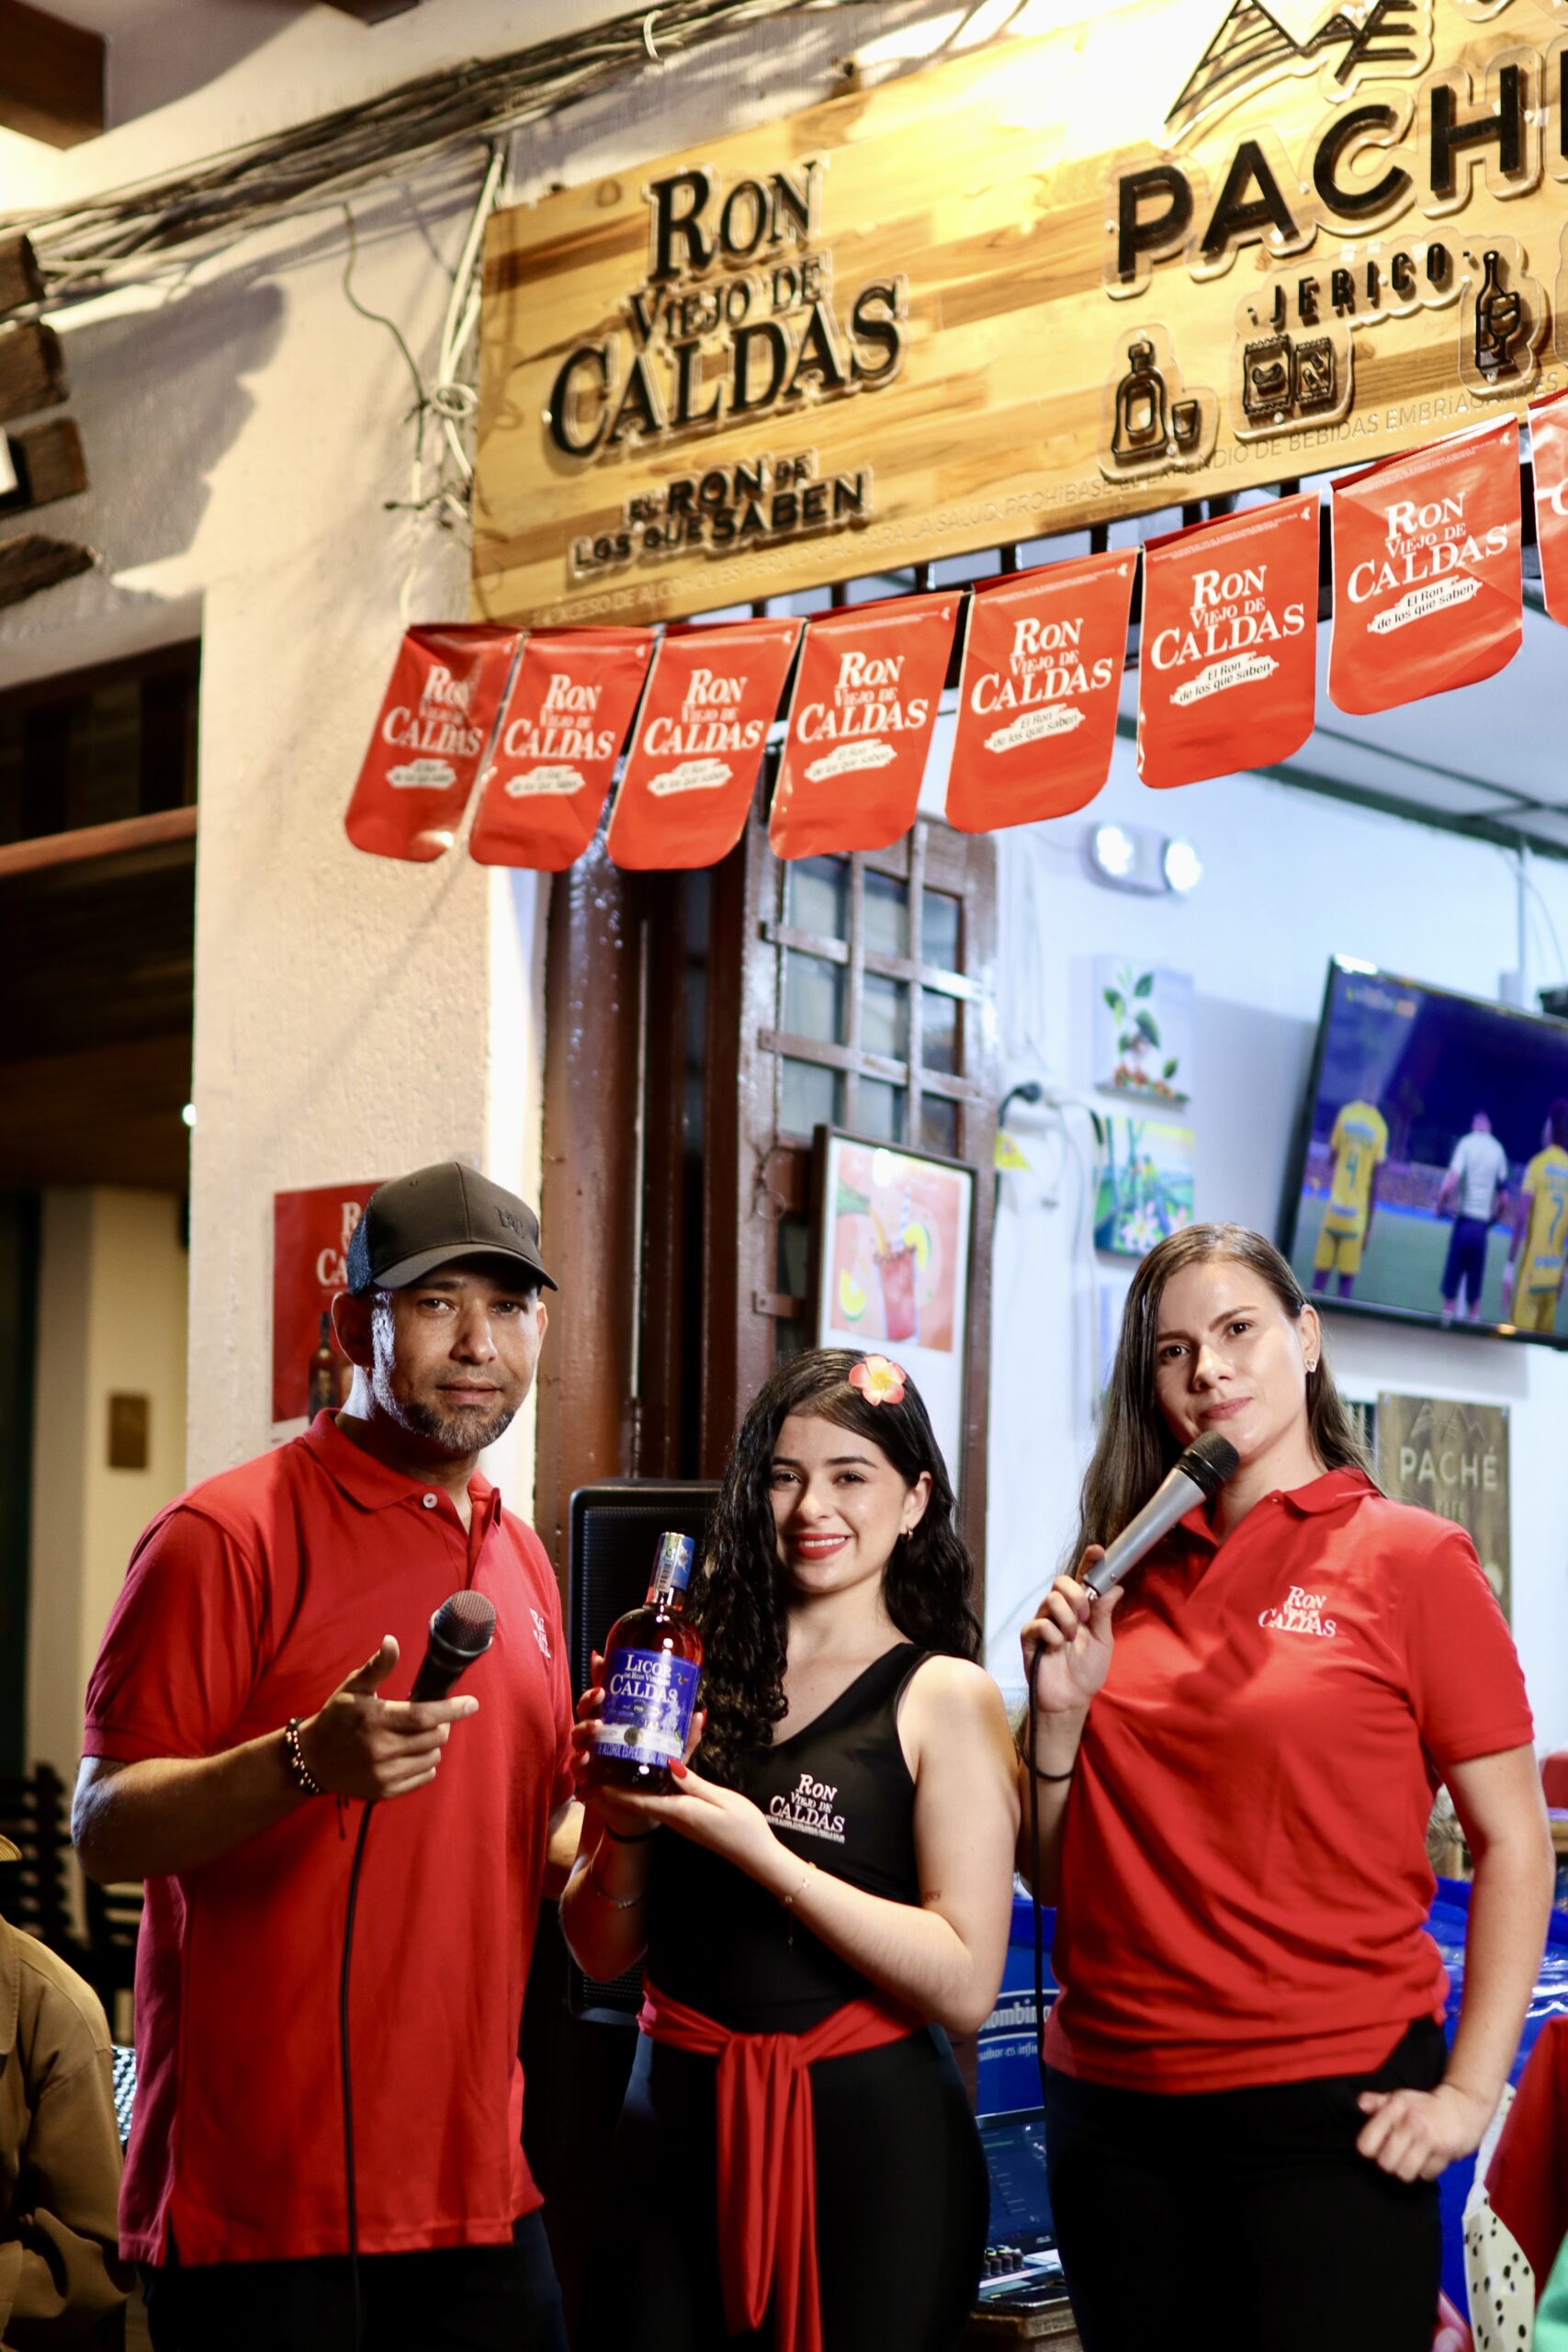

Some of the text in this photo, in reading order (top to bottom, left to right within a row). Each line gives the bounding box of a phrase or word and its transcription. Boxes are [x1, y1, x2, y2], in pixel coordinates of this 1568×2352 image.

[1118, 50, 1568, 274] PACH
[649, 159, 824, 282] RON
[629, 255, 824, 344] VIEJO DE
[548, 282, 901, 457] CALDAS
[1255, 437, 1282, 459] DE
[1289, 413, 1379, 452] BEBIDAS
[667, 459, 764, 514] RON
[775, 455, 808, 481] DE
[575, 471, 863, 567] LOS QUE SABEN
[1384, 492, 1466, 544] RON
[1385, 522, 1467, 559] VIEJO DE
[1348, 524, 1508, 604] CALDAS
[1190, 565, 1268, 611] RON
[1377, 583, 1474, 630] de los que saben
[1407, 586, 1444, 607] El Ron
[1190, 596, 1266, 631] VIEJO DE
[1010, 616, 1084, 660] RON
[1150, 603, 1305, 671] CALDAS
[836, 650, 905, 689] RON
[1010, 650, 1079, 678] VIEJO DE
[1179, 662, 1271, 702] de los que saben
[1220, 661, 1242, 676] Ron
[543, 673, 603, 711] RON
[685, 668, 748, 706] RON
[970, 657, 1113, 715] CALDAS
[503, 718, 615, 760] CALDAS
[643, 717, 764, 756] CALDAS
[795, 698, 930, 744] CALDAS
[1400, 1445, 1498, 1492] PACHÉ
[1287, 1585, 1327, 1610] RON
[1258, 1608, 1337, 1638] CALDAS
[626, 1654, 672, 1679] LICOR
[610, 1673, 679, 1703] CALDAS
[798, 1773, 838, 1802] RON
[770, 1794, 845, 1833] CALDAS
